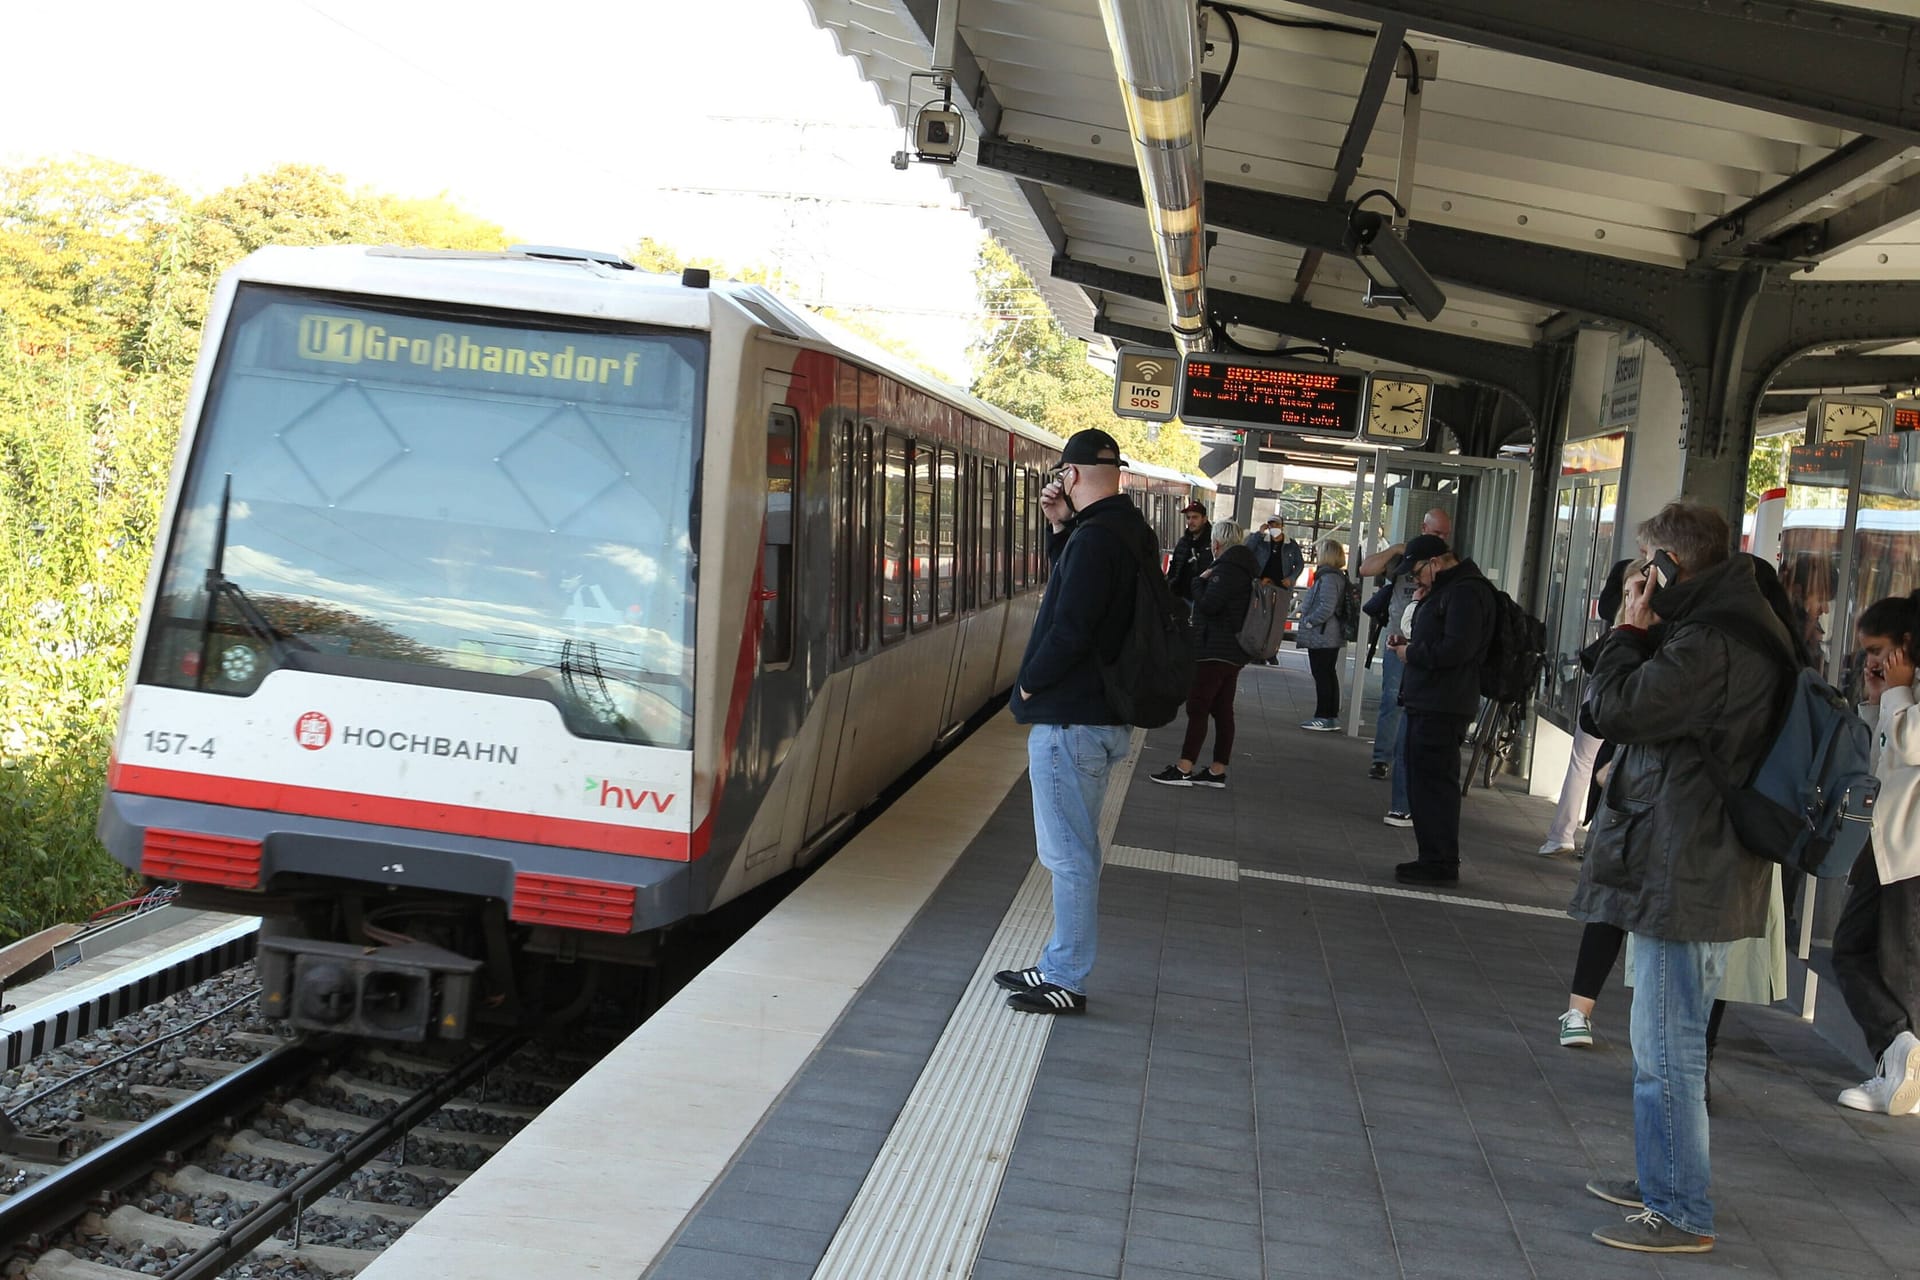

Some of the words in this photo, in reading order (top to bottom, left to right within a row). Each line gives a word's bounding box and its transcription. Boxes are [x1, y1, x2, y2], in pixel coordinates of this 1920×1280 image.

[365, 325, 641, 386] Großhansdorf
[1131, 385, 1160, 398] Info
[1227, 367, 1339, 389] GROSSHANSDORF
[1131, 397, 1159, 409] SOS
[144, 730, 216, 760] 157-4
[342, 726, 518, 765] HOCHBAHN
[600, 779, 675, 814] hvv
